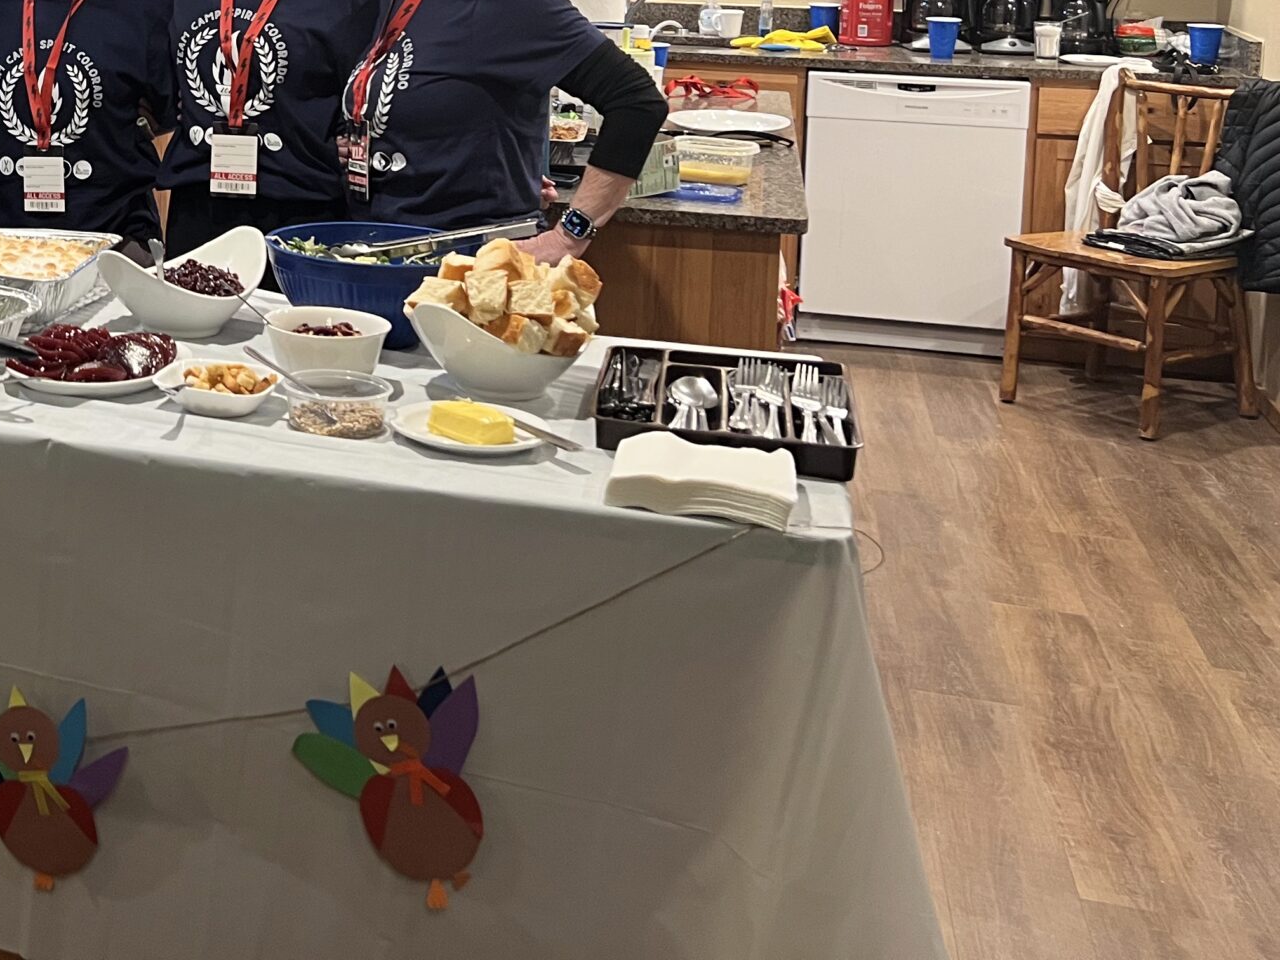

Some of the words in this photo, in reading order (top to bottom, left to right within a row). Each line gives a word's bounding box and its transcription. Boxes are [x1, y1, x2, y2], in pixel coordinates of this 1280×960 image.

[76, 51, 104, 108] COLORADO
[176, 31, 190, 65] TEAM
[264, 22, 289, 84] COLORADO
[213, 172, 226, 180] ALL
